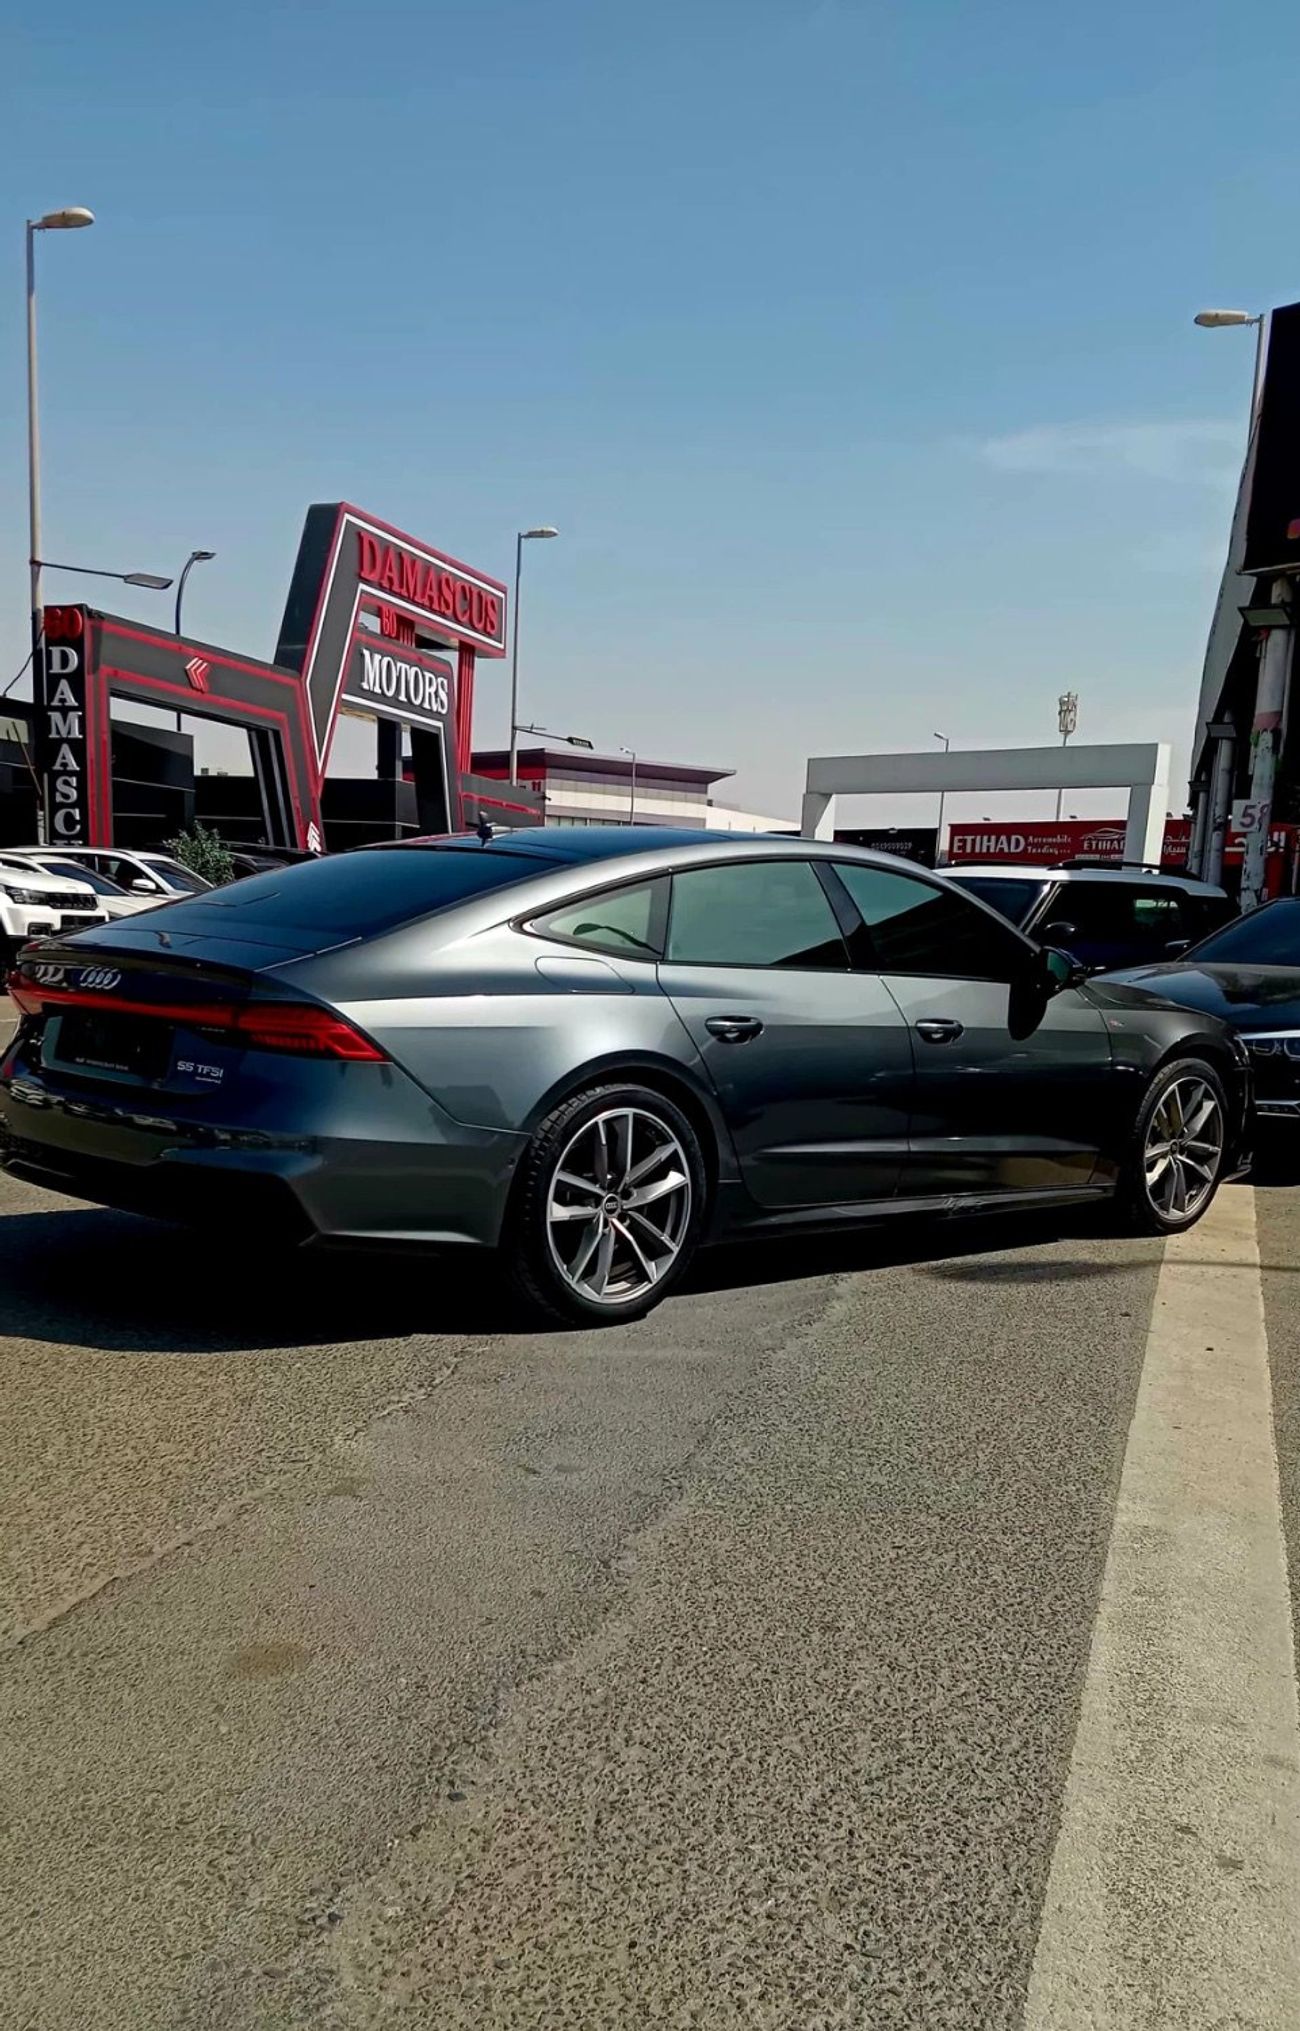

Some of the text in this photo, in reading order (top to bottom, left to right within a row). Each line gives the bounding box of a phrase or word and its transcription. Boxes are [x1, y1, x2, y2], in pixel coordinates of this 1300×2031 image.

[359, 530, 498, 636] DAMASCUS
[361, 648, 449, 715] MOTORS
[48, 646, 83, 847] DAMASC
[953, 834, 1025, 854] ETIHAD
[196, 1063, 224, 1078] TFSI
